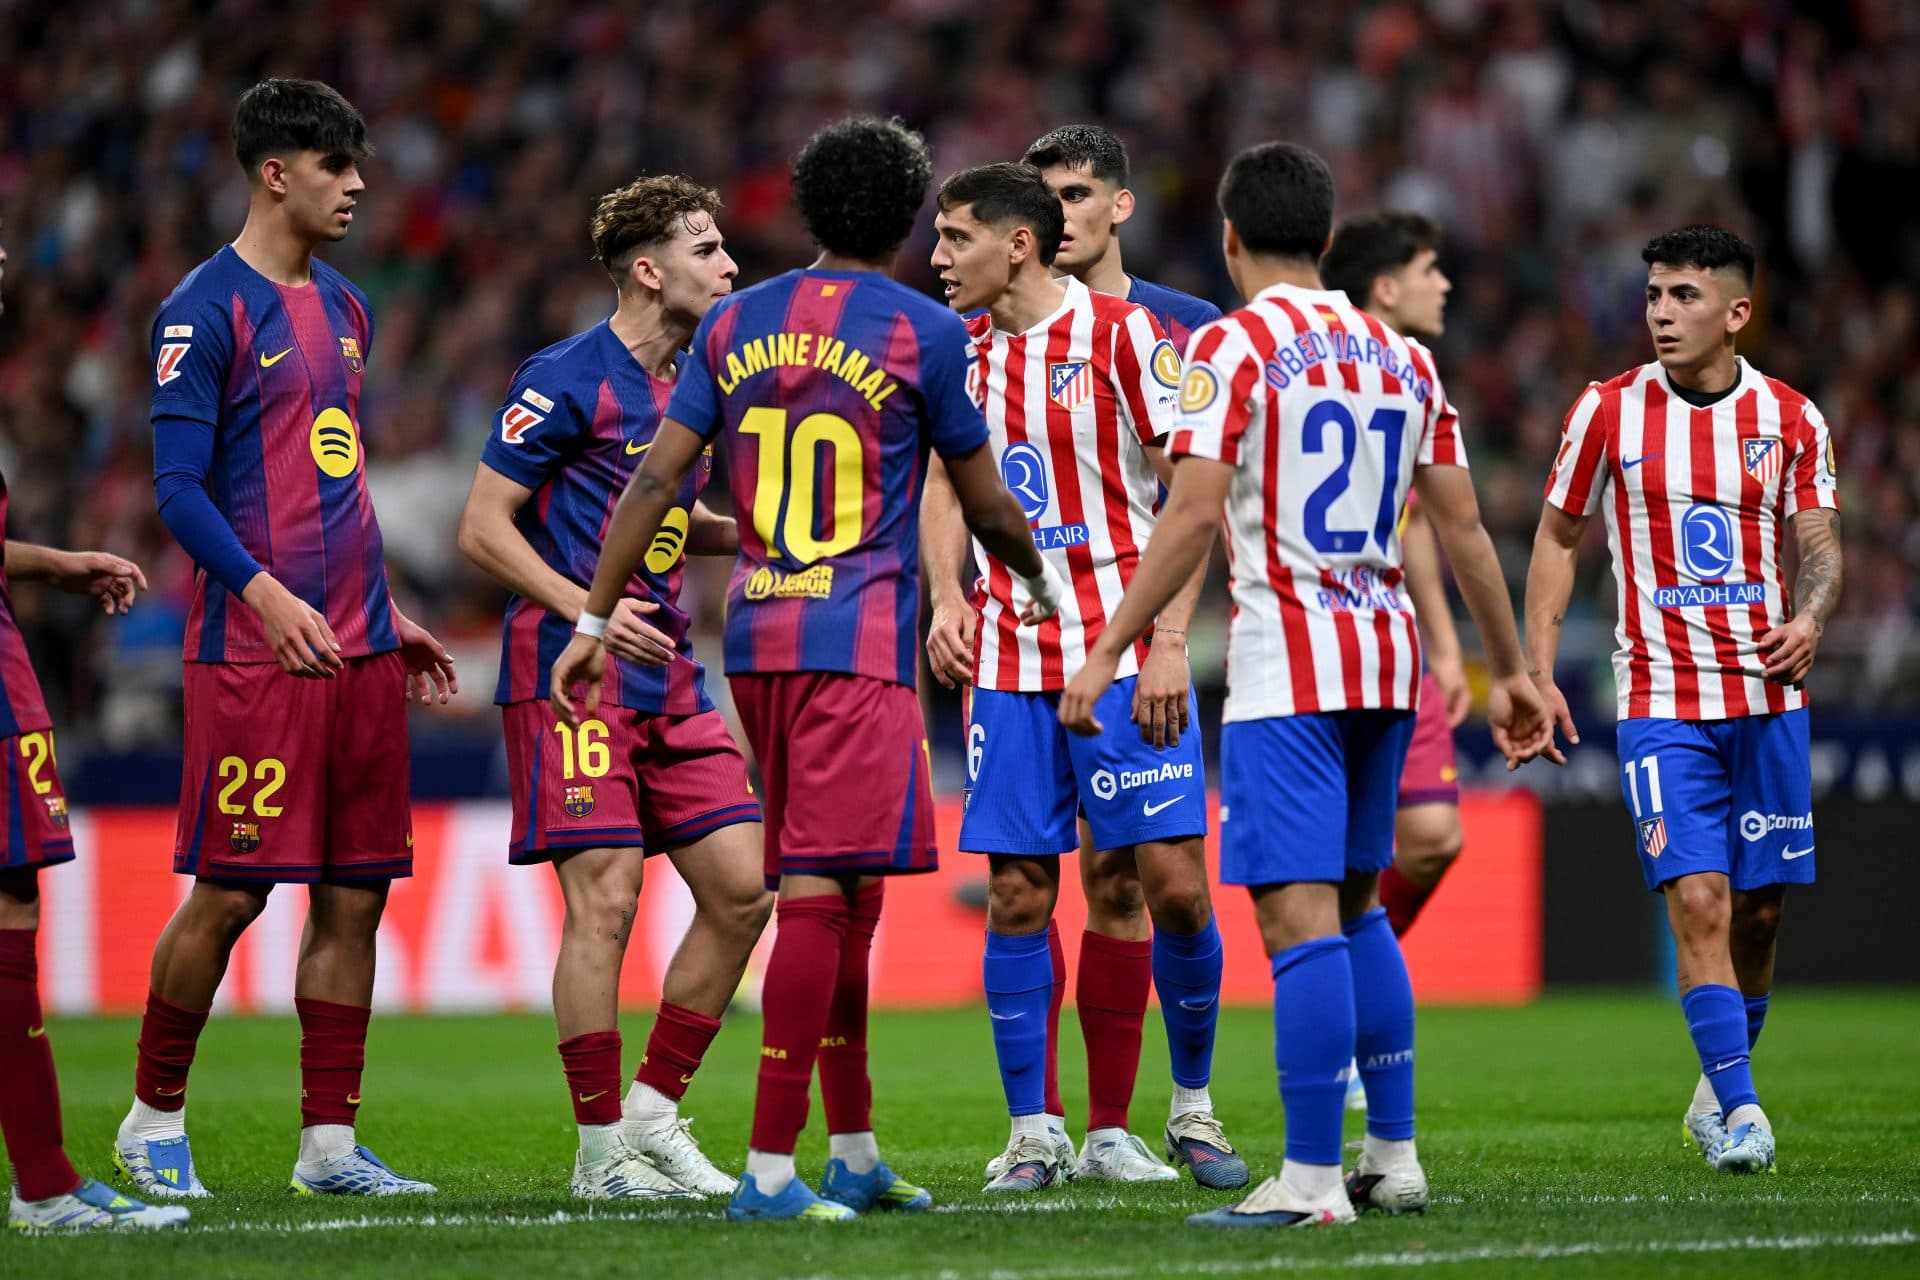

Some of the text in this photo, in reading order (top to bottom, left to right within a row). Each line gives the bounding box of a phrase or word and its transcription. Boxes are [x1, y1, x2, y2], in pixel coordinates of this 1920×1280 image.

[718, 333, 898, 411] LAMINE YAMAL
[1265, 332, 1328, 389] OBED
[738, 407, 863, 564] 10
[1302, 400, 1406, 558] 21
[1051, 526, 1086, 546] AIR
[1659, 584, 1762, 606] RIYADH AIR
[554, 719, 610, 779] 16
[1120, 763, 1193, 789] ComAve
[218, 755, 286, 817] 22
[1625, 755, 1663, 817] 11
[1767, 812, 1814, 831] ComA
